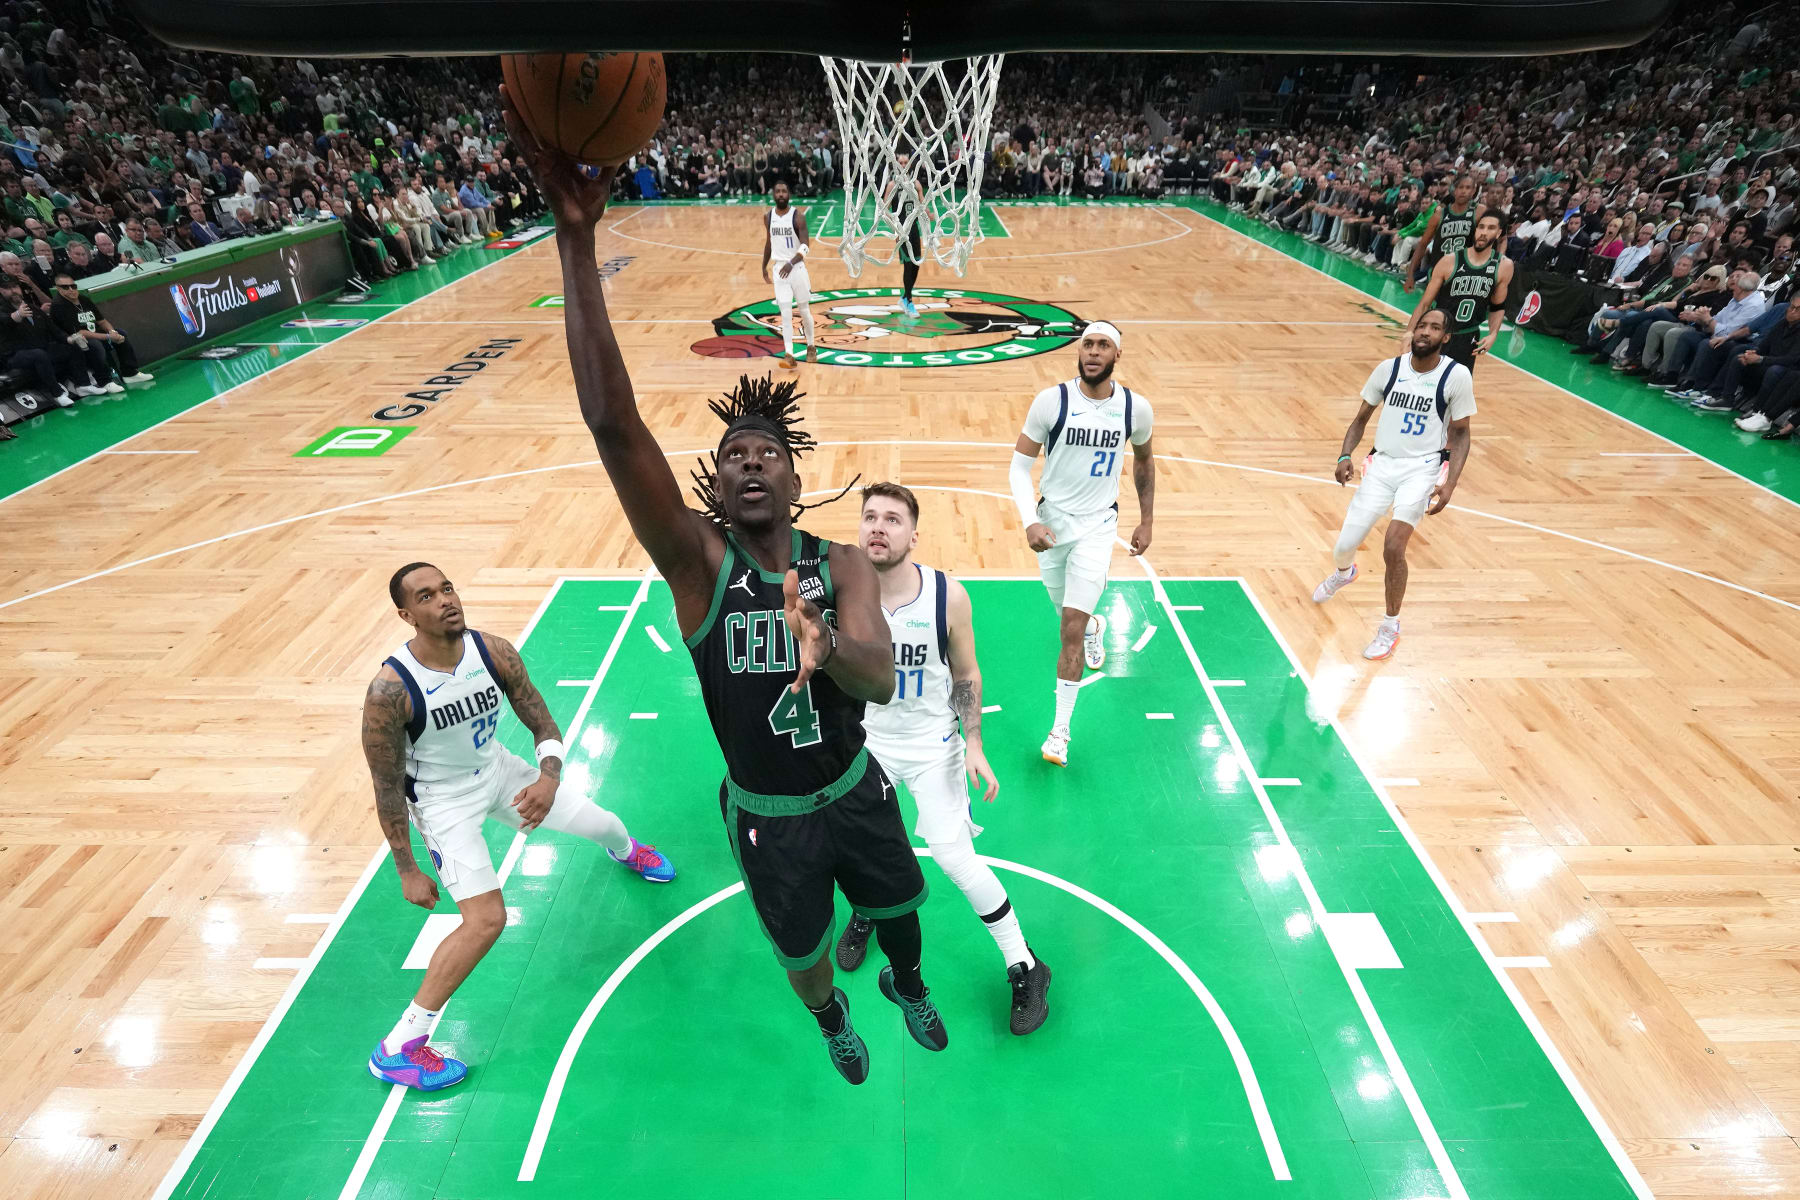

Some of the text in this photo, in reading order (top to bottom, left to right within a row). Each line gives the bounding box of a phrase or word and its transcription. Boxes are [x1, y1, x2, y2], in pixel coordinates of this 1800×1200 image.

[771, 227, 793, 236] DALLAS
[1441, 220, 1472, 238] CELTICS
[785, 236, 794, 249] 11
[1441, 237, 1466, 255] 42
[773, 288, 967, 304] ELTICS
[1450, 276, 1493, 298] CELTICS
[188, 275, 248, 338] Finals
[1455, 299, 1476, 322] 0
[371, 337, 523, 422] GARDEN
[1389, 391, 1433, 412] DALLAS
[1400, 412, 1428, 435] 55
[1065, 427, 1121, 448] DALLAS
[1090, 451, 1116, 477] 21
[797, 557, 820, 566] WALTON
[906, 620, 930, 628] chime
[465, 667, 485, 680] chime
[430, 685, 499, 731] DALLAS
[768, 680, 822, 749] 4
[471, 709, 499, 750] 25
